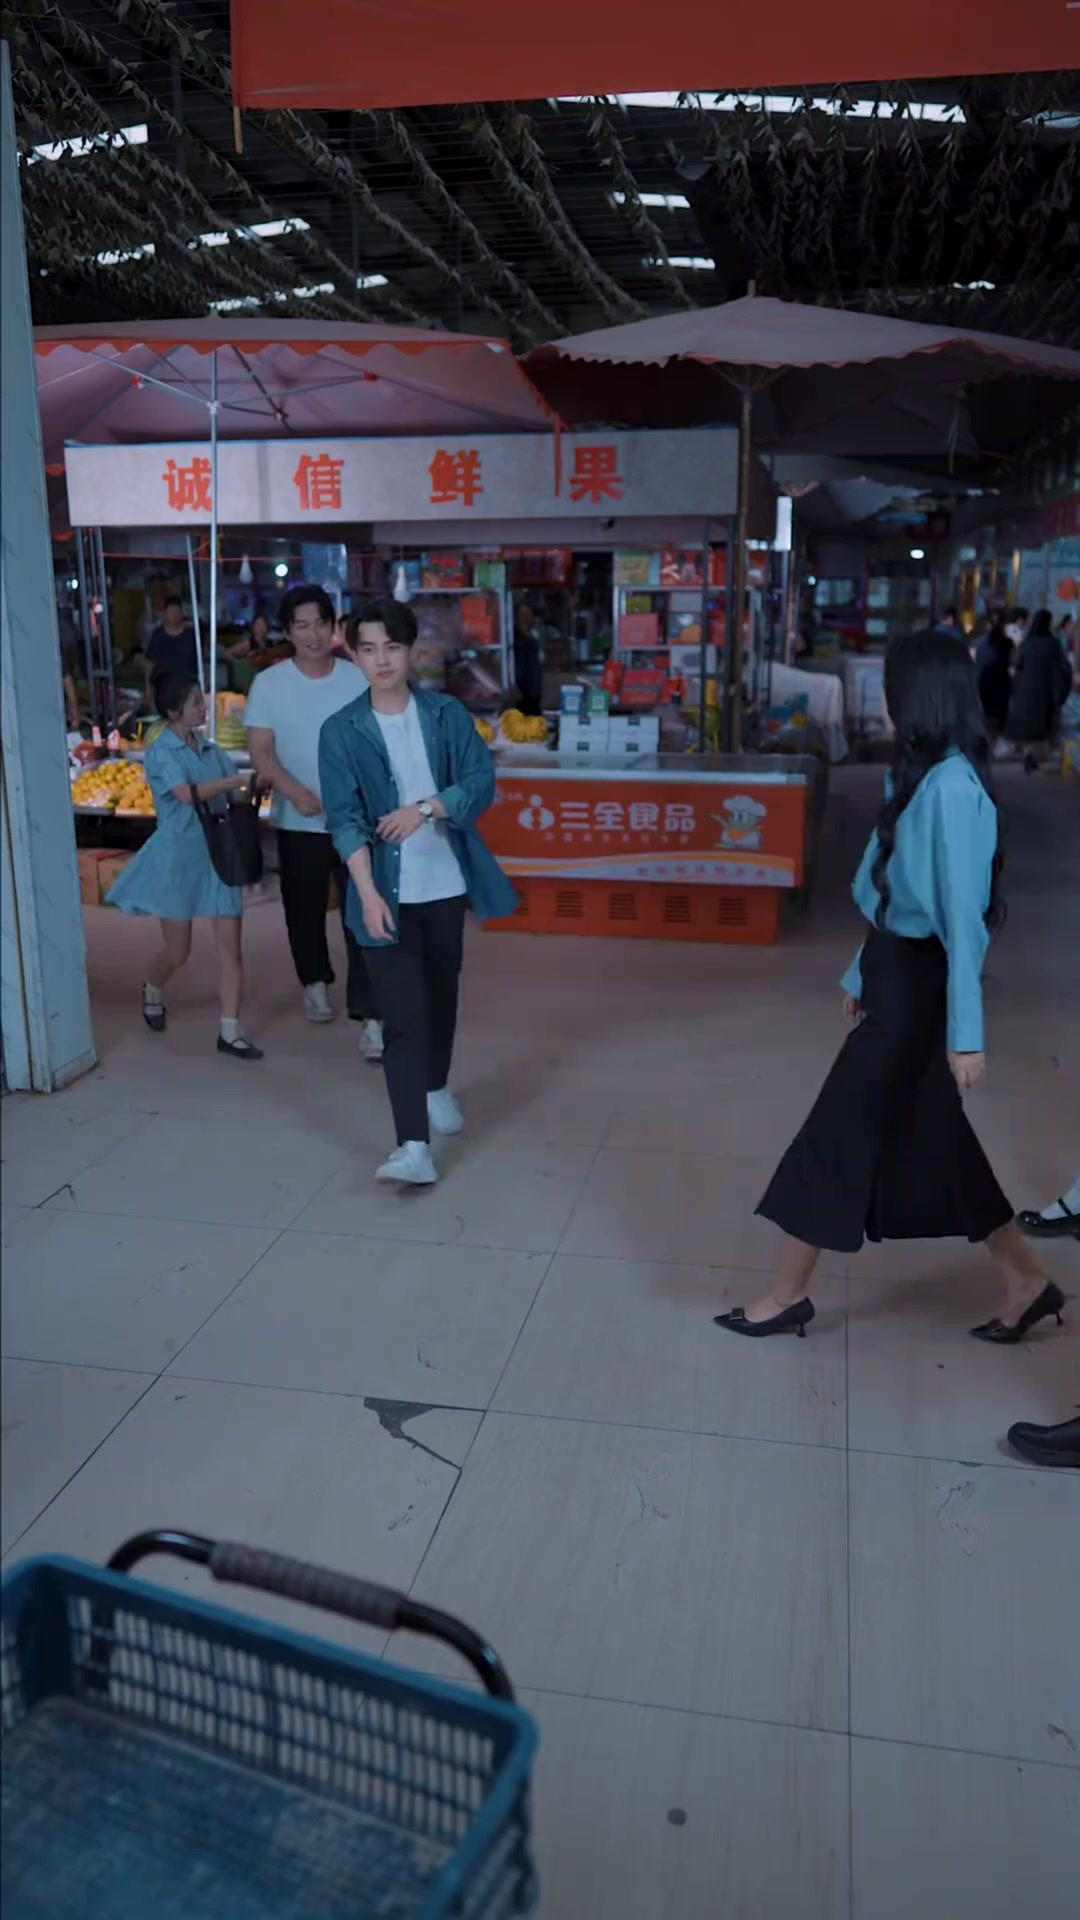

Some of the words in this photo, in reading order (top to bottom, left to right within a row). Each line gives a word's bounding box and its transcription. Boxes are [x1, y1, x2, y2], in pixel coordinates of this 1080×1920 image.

[162, 445, 624, 512] 诚信鲜果
[559, 801, 696, 832] 三全食品
